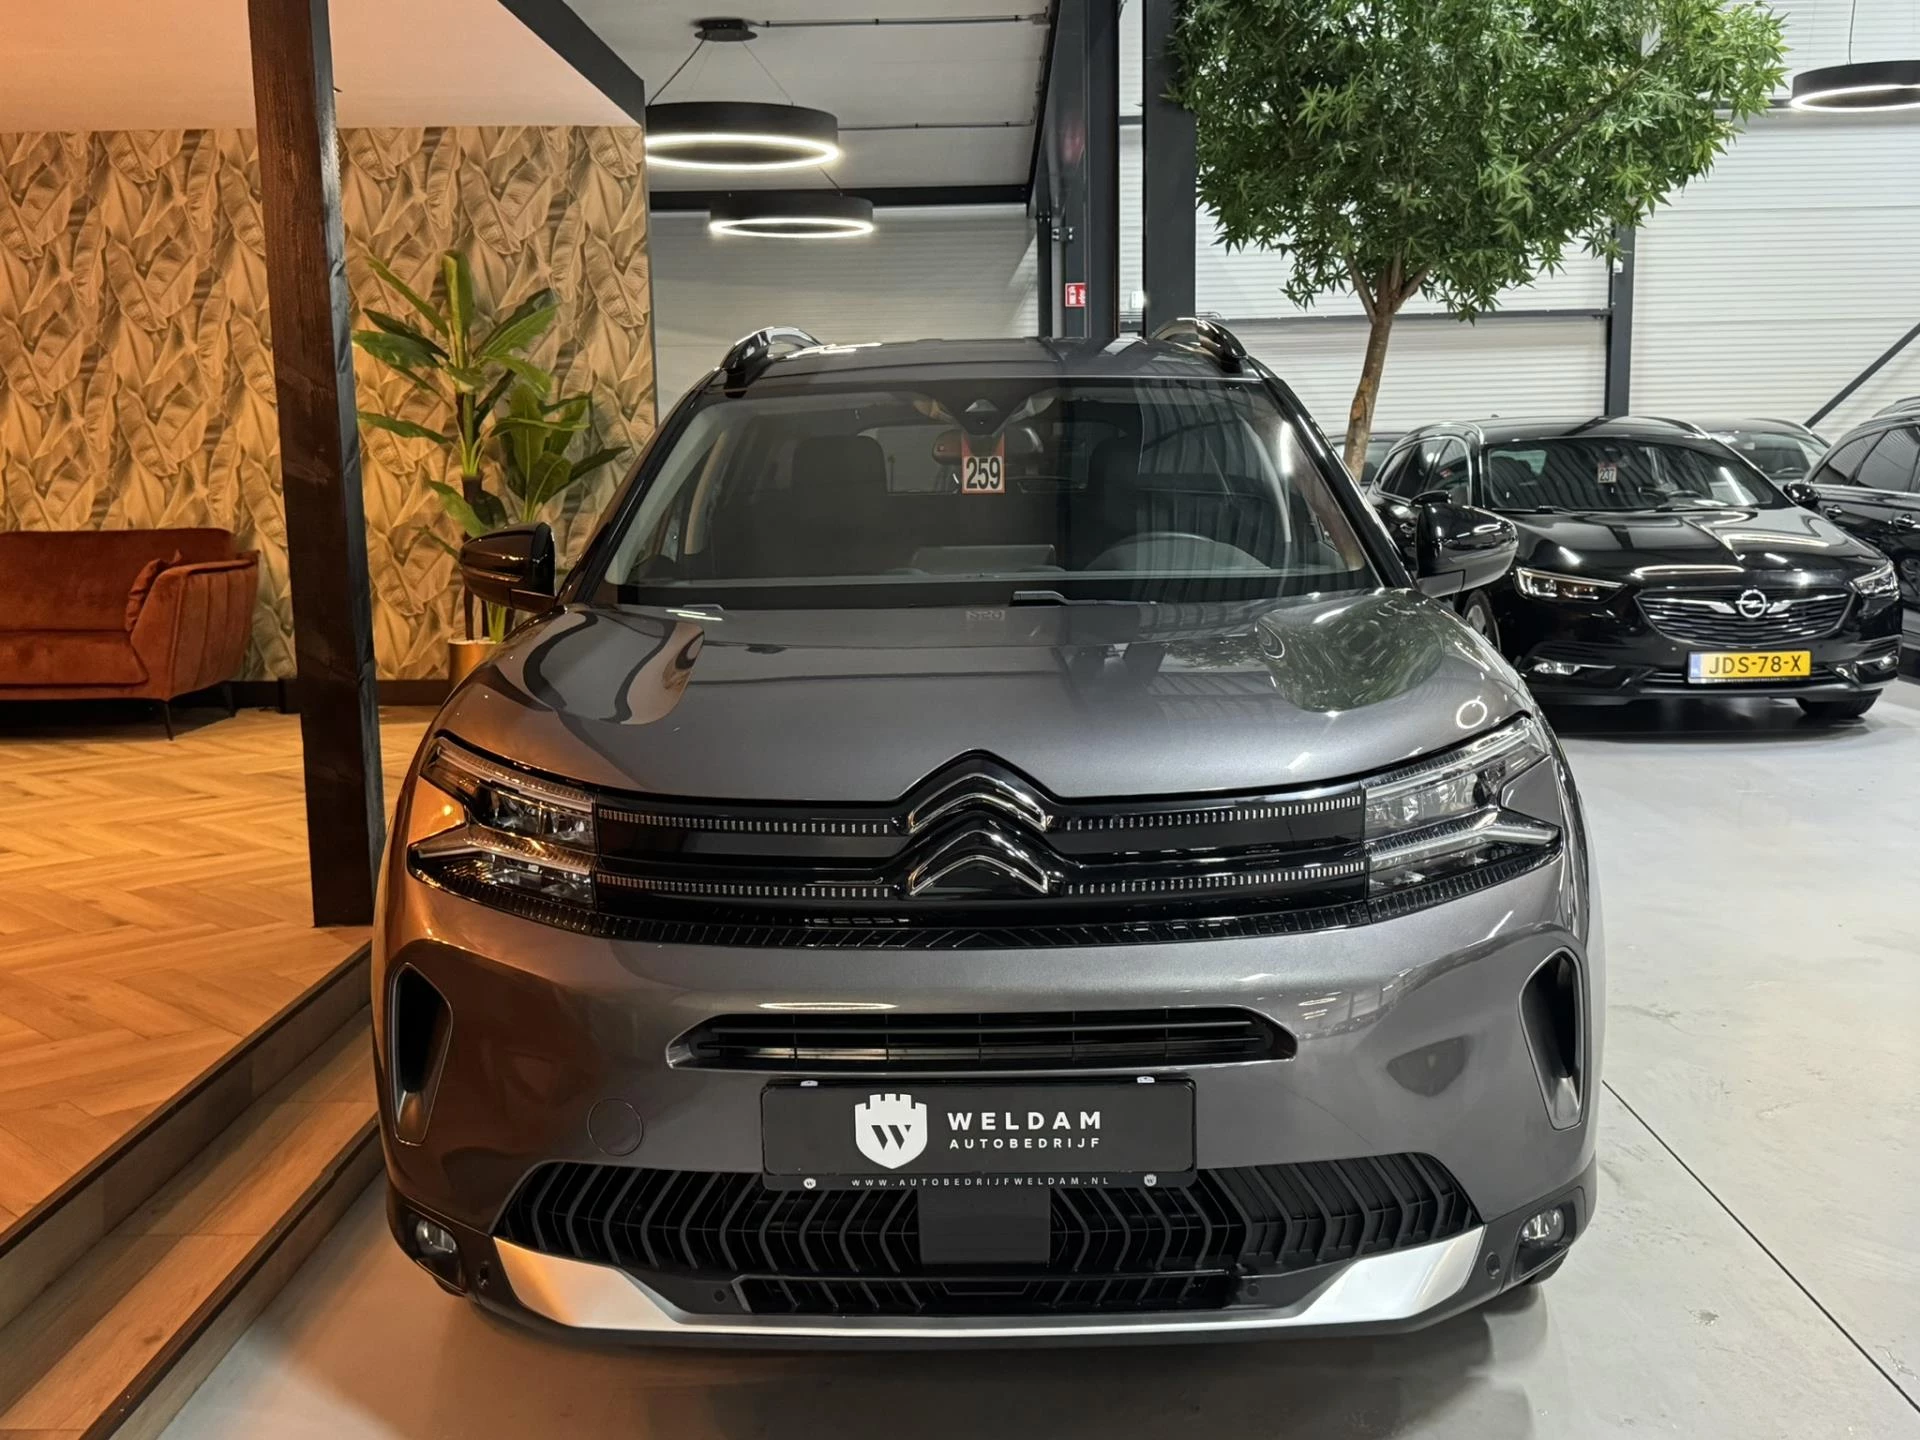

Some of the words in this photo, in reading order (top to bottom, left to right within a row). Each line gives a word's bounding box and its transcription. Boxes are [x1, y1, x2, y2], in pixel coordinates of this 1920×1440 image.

[966, 457, 1000, 489] 259
[1709, 655, 1801, 674] JDS-78-X
[947, 1111, 1101, 1131] WELDAM
[870, 1124, 912, 1151] W
[949, 1137, 1101, 1150] AUTOBEDRIJF
[851, 1176, 1109, 1187] WWW.AUTOBEDRIJFWELDAM.NL
